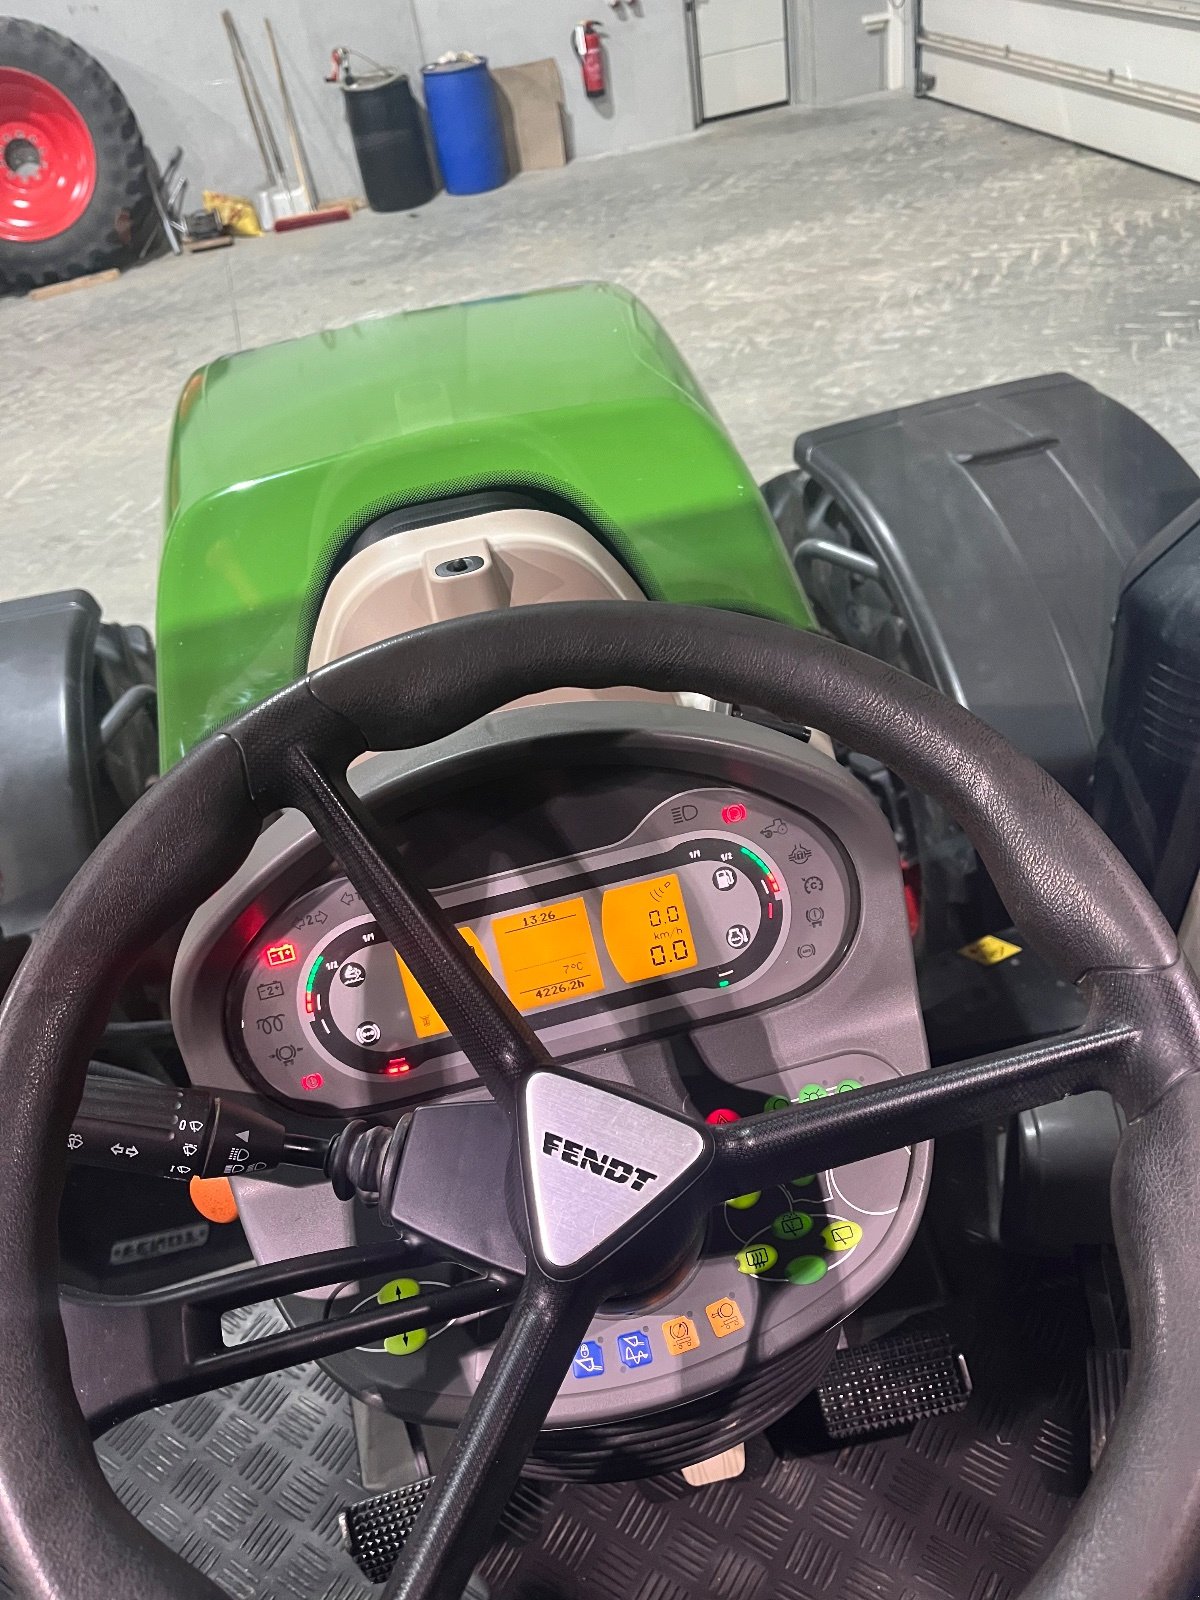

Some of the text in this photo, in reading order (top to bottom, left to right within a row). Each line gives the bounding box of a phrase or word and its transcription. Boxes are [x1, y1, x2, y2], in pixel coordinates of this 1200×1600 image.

[523, 911, 556, 927] 13:26
[648, 905, 680, 927] 0.0
[654, 926, 683, 941] km/h
[650, 939, 689, 967] 0.0
[563, 961, 584, 975] 7°C
[535, 980, 585, 999] 4226.2h
[542, 1131, 658, 1192] FENDT
